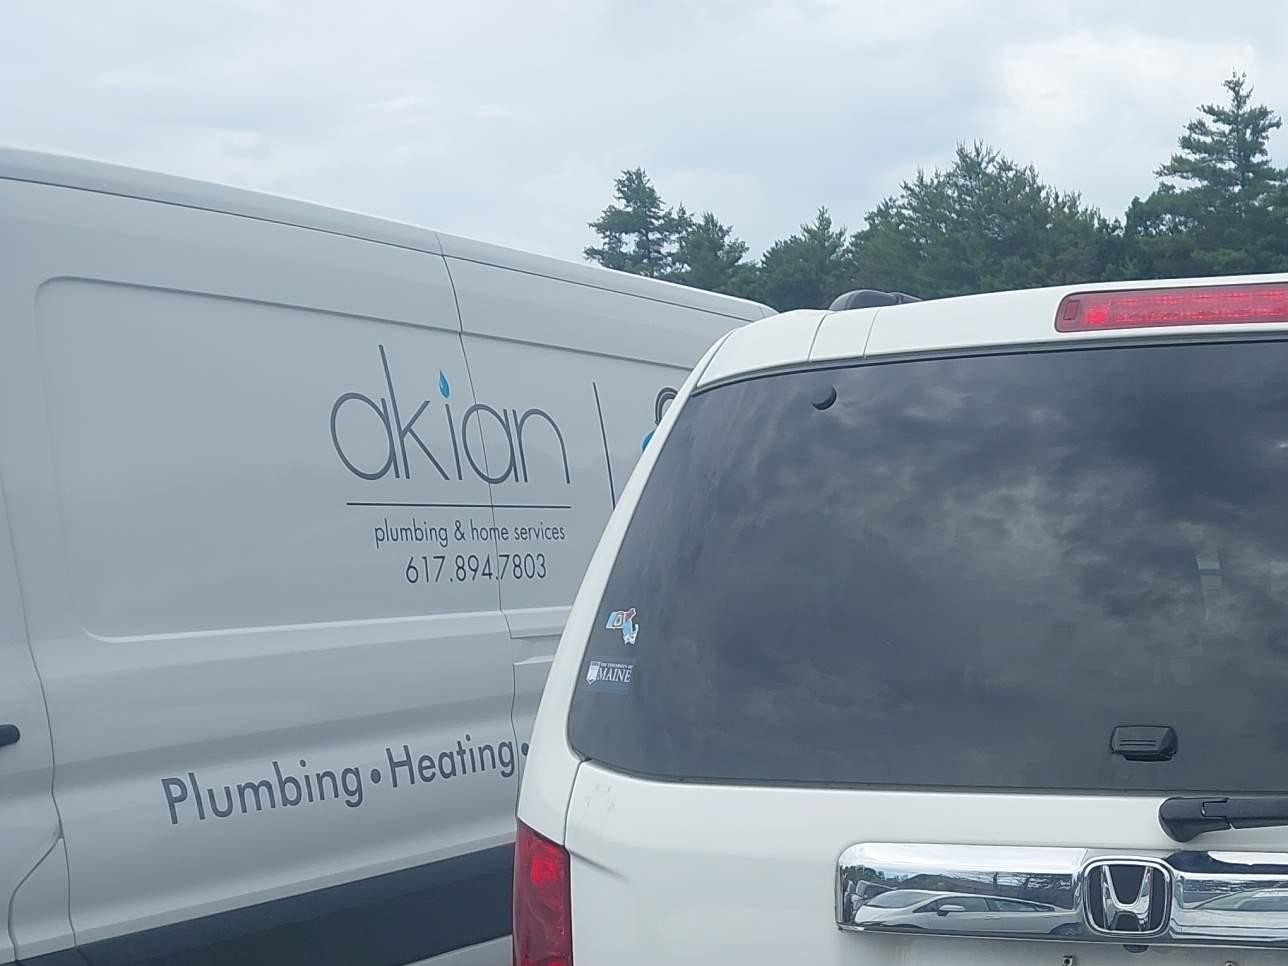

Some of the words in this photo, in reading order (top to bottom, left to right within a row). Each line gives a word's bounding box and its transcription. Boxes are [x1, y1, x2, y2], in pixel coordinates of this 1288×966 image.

[330, 344, 571, 485] akian
[374, 519, 449, 549] plumbing
[454, 521, 466, 541] &
[470, 518, 509, 541] home
[514, 524, 566, 541] services
[405, 553, 547, 584] 617.894.7803
[597, 667, 632, 683] MAINE
